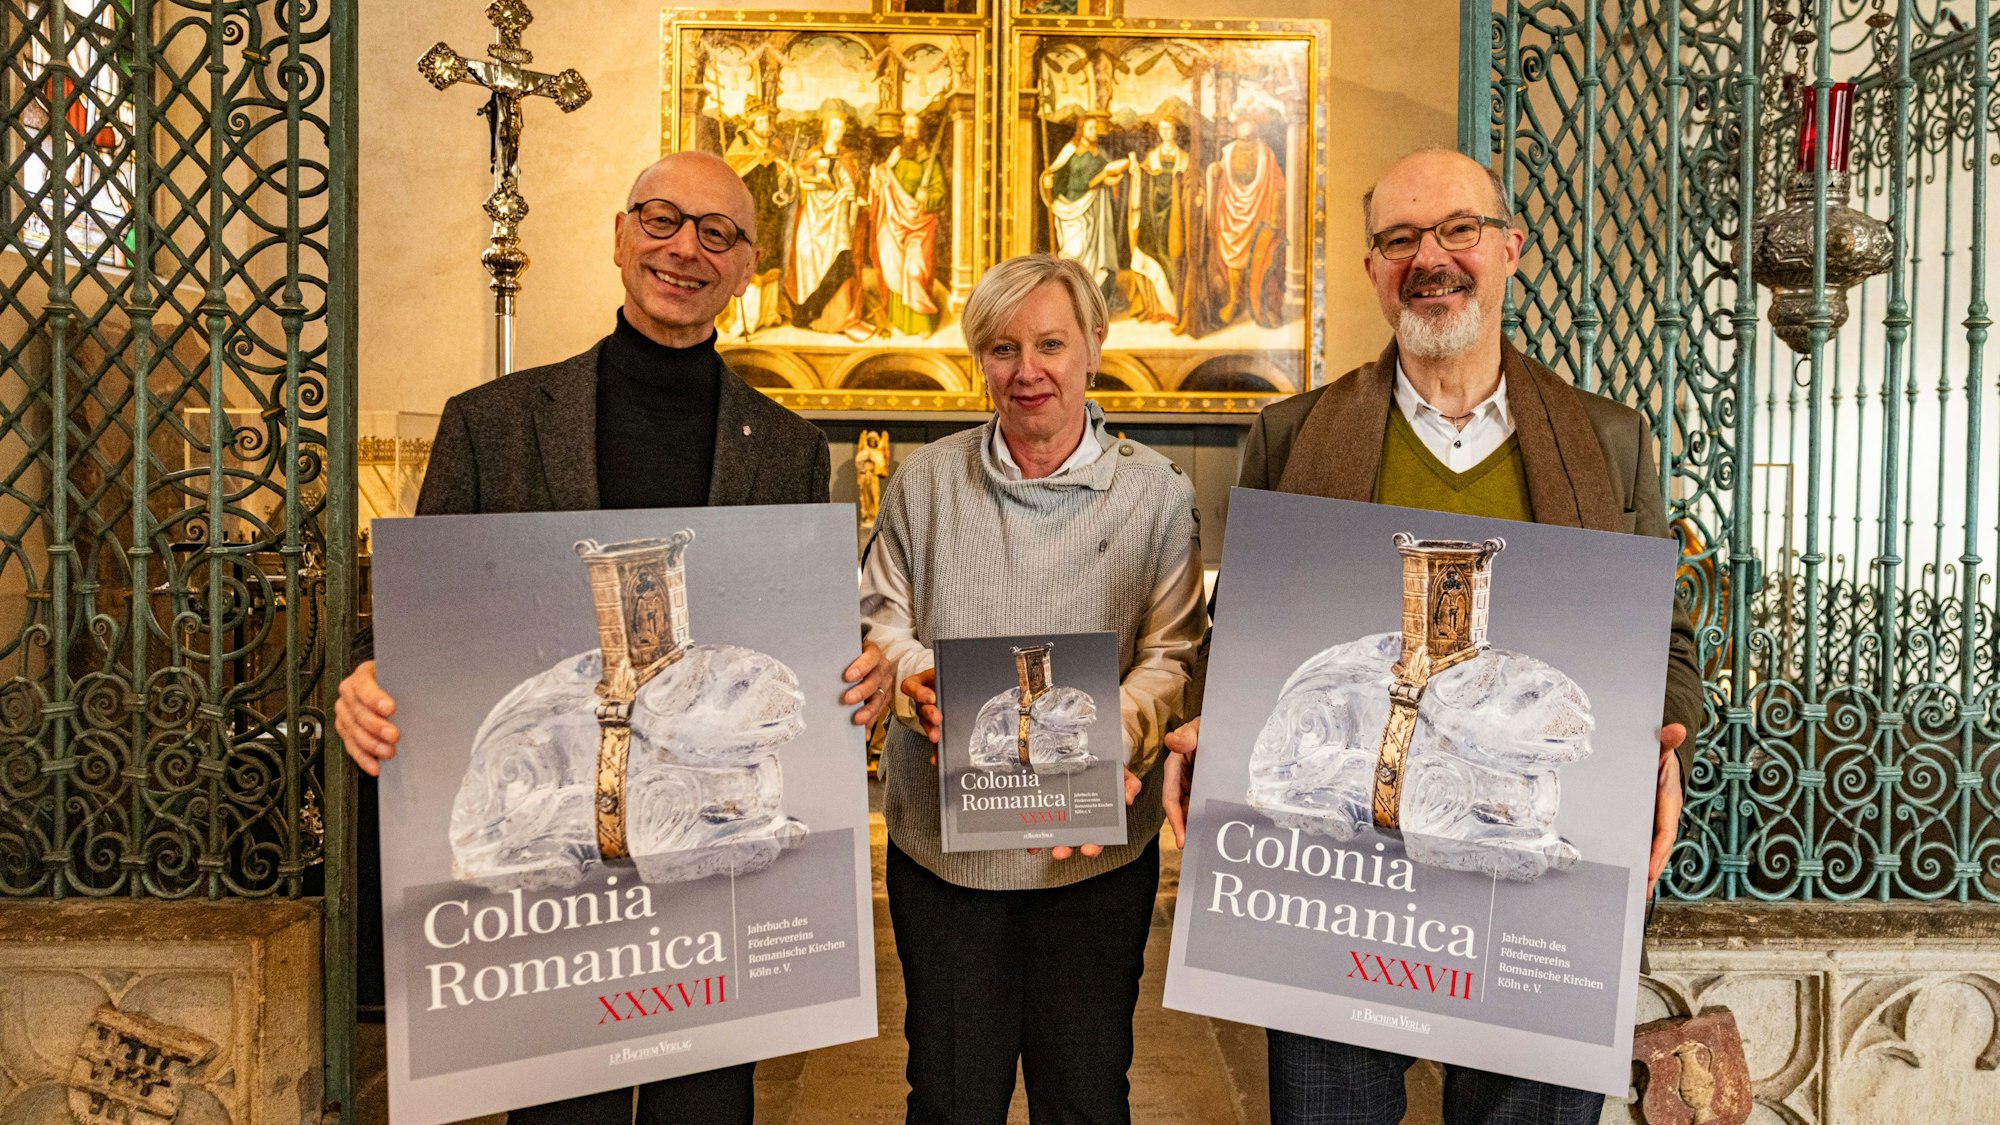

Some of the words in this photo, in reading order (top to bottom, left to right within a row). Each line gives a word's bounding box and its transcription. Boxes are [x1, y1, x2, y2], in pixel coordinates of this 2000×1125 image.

[960, 769, 1040, 790] Colonia
[961, 789, 1067, 811] Romanica
[1018, 810, 1068, 825] XXXVII
[1216, 820, 1416, 893] Colonia
[423, 875, 657, 949] Colonia
[1207, 871, 1478, 959] Romanica
[747, 918, 790, 936] Jahrbuch
[791, 917, 808, 927] des
[748, 931, 814, 949] Fördervereins
[1501, 932, 1547, 949] Jahrbuch
[1549, 940, 1567, 953] des
[749, 946, 807, 964] Romanische
[808, 940, 845, 954] Kirchen
[1500, 947, 1571, 969] Fördervereins
[425, 926, 727, 1011] Romanica
[749, 965, 772, 979] Köln
[1347, 951, 1475, 1000] XXXVII
[1499, 962, 1561, 982] Romanische
[1563, 974, 1604, 990] Kirchen
[1497, 977, 1521, 990] Köln
[1533, 983, 1542, 994] V.
[597, 975, 726, 1025] XXXVII
